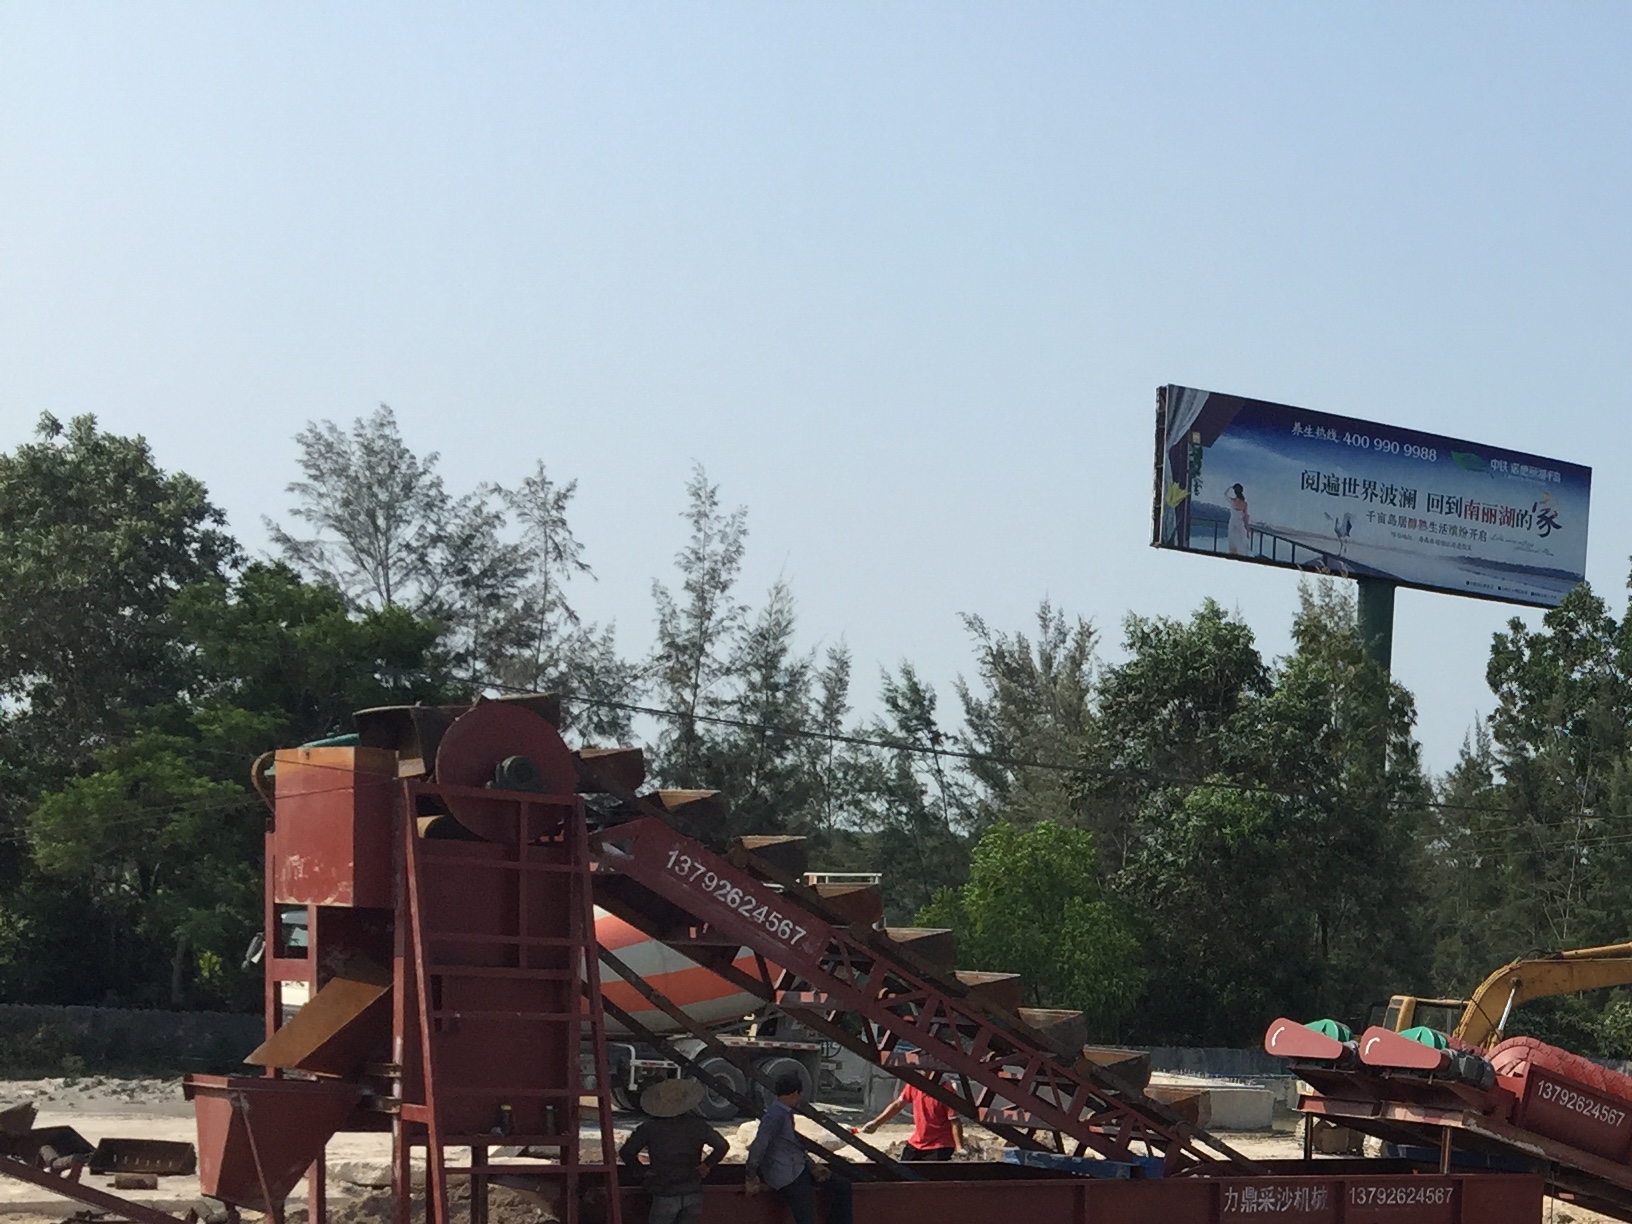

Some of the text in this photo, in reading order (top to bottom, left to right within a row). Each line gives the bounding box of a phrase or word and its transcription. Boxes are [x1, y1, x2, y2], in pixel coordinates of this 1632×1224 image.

[1343, 432, 1370, 449] 400
[1373, 438, 1400, 454] 990
[1404, 444, 1437, 462] 9988
[1301, 469, 1563, 538] 阅遍世界波澜 回到南丽湖的家
[667, 849, 807, 946] 13792624567
[1538, 1080, 1625, 1127] 13792624567
[1224, 1186, 1454, 1213] 力鼎采沙机械 13792624567
